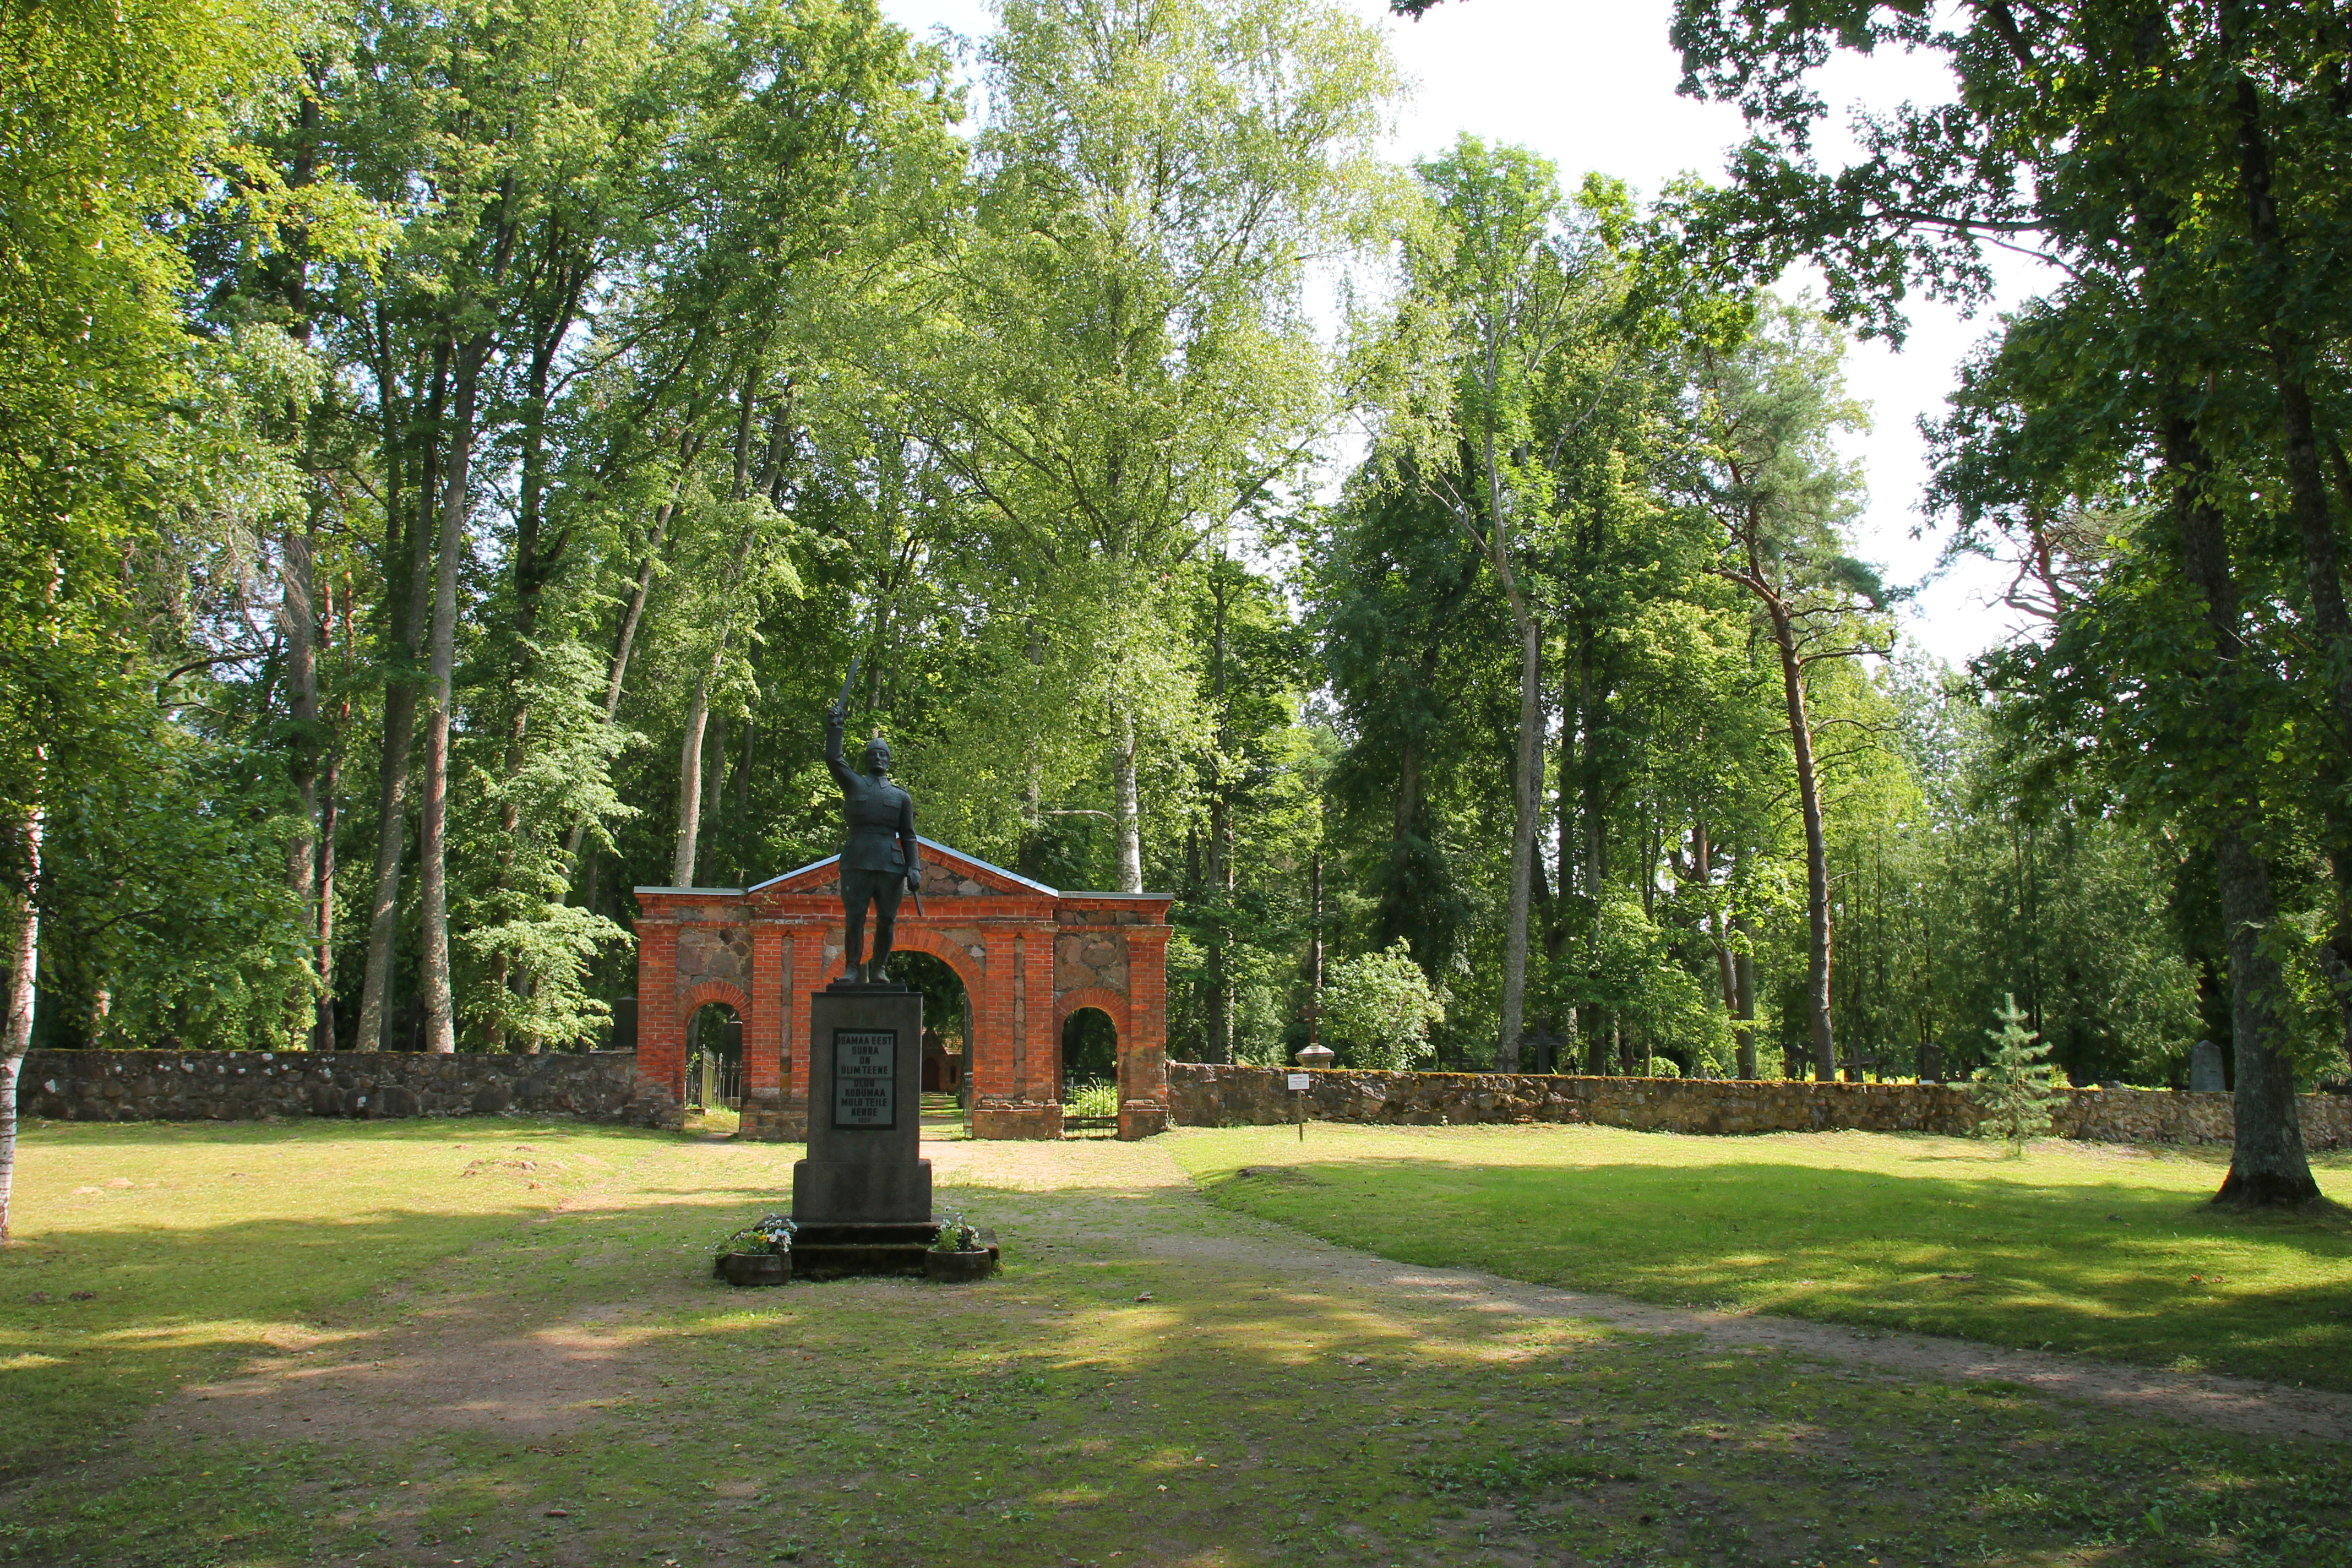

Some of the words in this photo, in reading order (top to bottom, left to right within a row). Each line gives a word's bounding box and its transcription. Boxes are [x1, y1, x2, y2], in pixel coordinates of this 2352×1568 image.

[838, 1036, 869, 1044] ISAMAA
[872, 1036, 893, 1045] EEST
[852, 1046, 879, 1055] SURRA
[859, 1056, 870, 1064] ON
[841, 1064, 860, 1074] ÜLIM
[862, 1066, 888, 1074] TEENE
[854, 1079, 875, 1087] OLGU
[845, 1088, 886, 1097] KODUMAA
[841, 1098, 863, 1106] MULD
[865, 1098, 888, 1107] TEILE
[851, 1108, 878, 1116] KERGE
